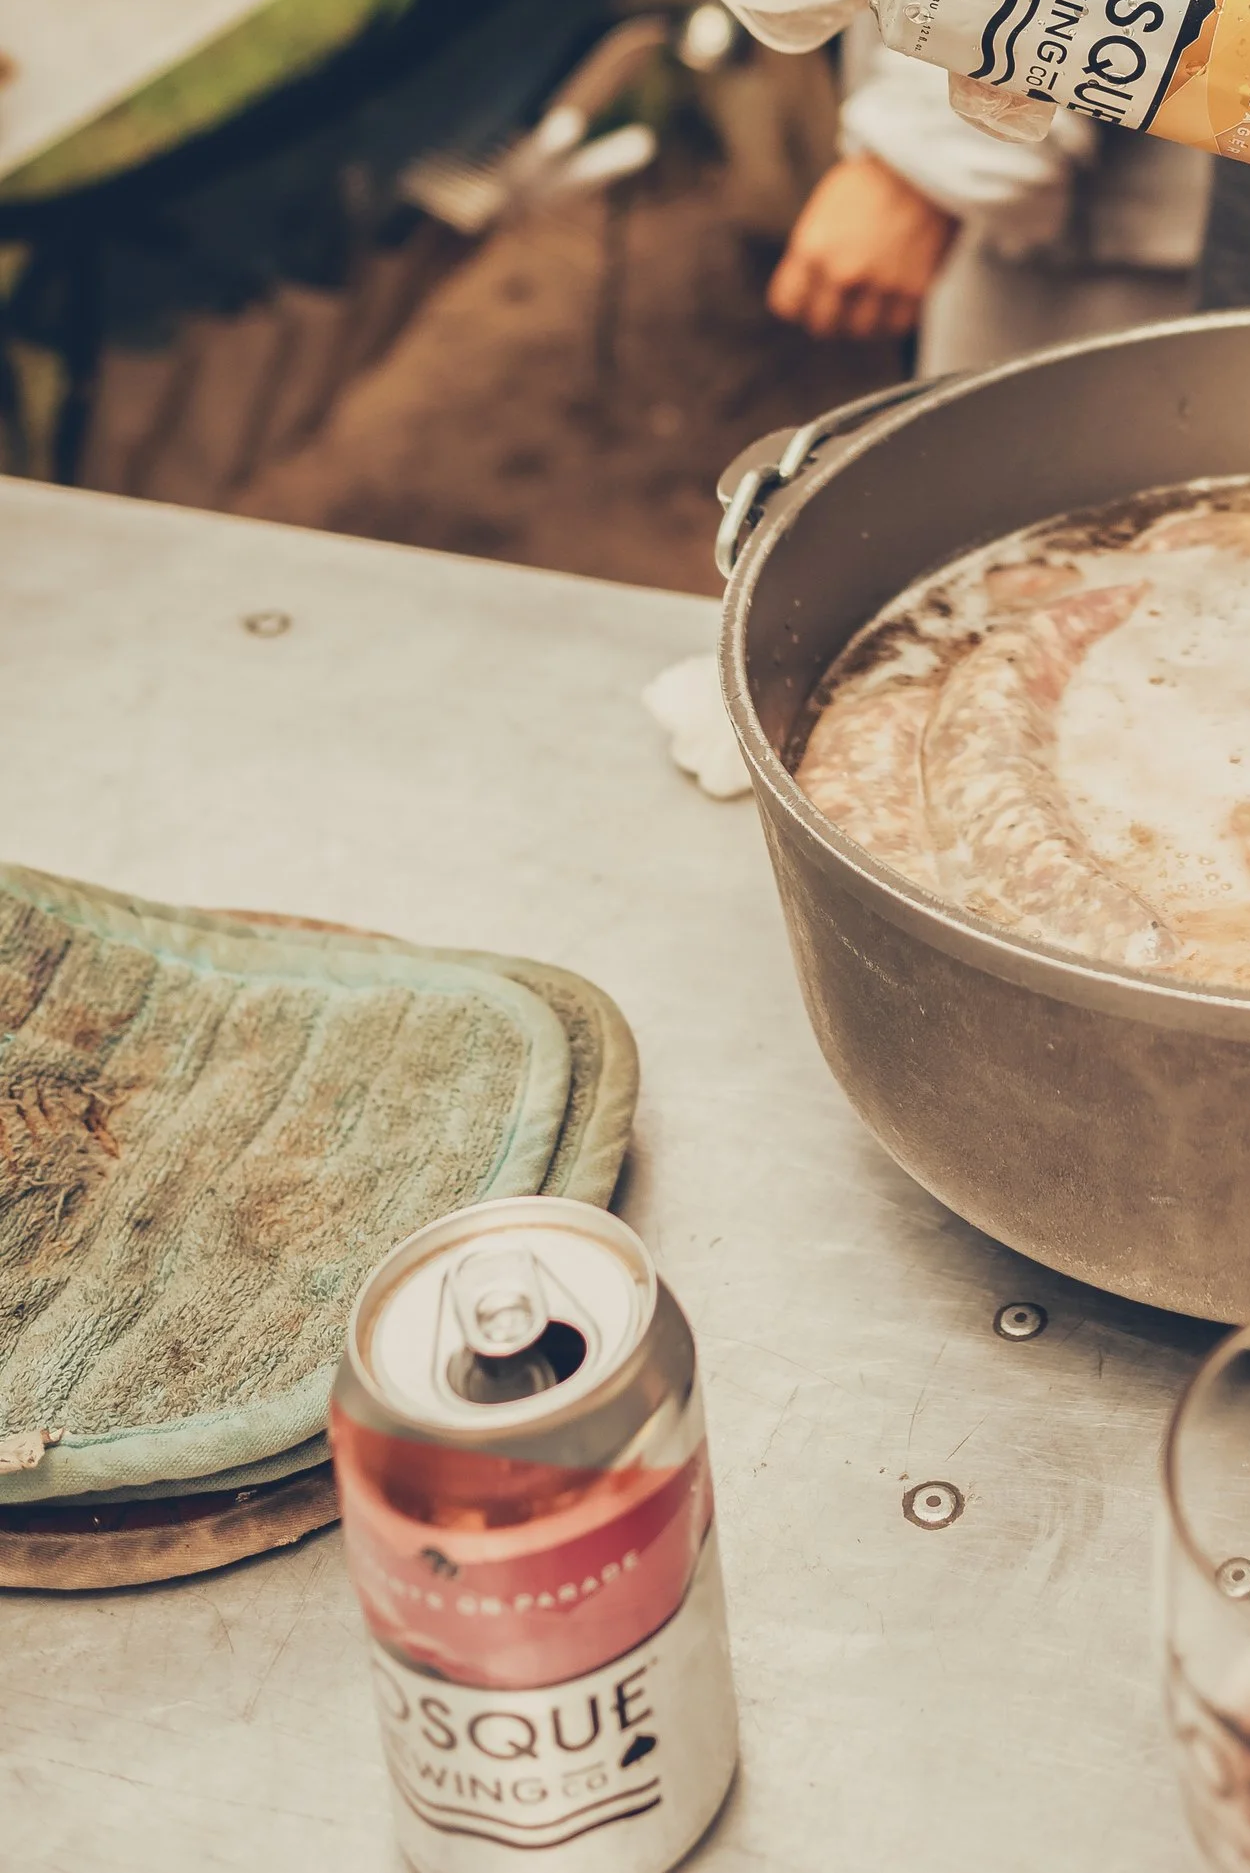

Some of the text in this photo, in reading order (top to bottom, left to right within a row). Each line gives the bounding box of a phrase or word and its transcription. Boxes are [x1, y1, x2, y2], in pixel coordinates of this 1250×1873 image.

[920, 24, 931, 35] 12
[373, 1663, 654, 1761] OSQUE
[411, 1750, 549, 1806] WING
